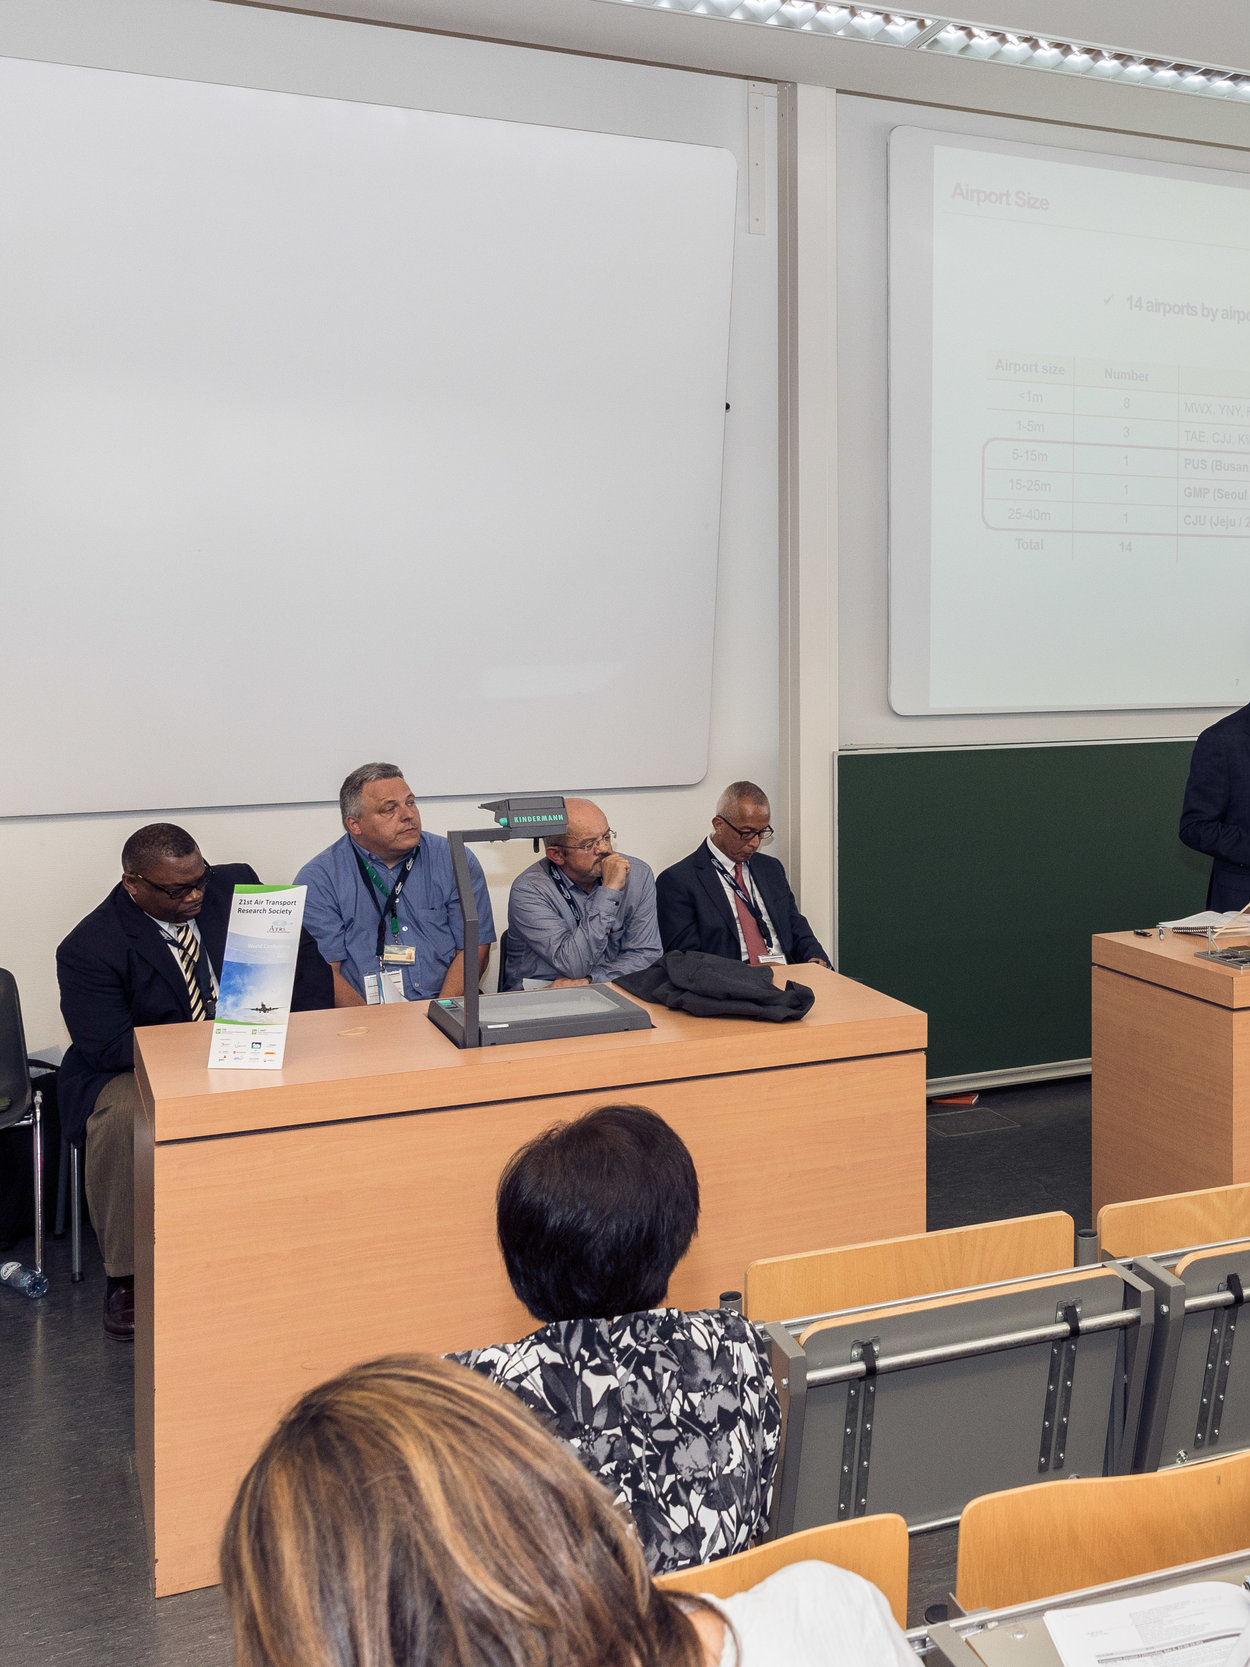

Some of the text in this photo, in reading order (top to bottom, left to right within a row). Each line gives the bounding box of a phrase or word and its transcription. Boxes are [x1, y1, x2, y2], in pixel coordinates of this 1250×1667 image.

[951, 182, 1049, 211] Airport Size
[1126, 296, 1143, 311] 14
[1146, 298, 1198, 317] airports
[1201, 303, 1218, 322] by
[995, 359, 1066, 376] Airport size
[1104, 367, 1149, 382] Number
[1016, 420, 1045, 432] 1-5m
[1012, 449, 1048, 462] 5-15m
[1184, 458, 1207, 471] PUS
[1211, 459, 1249, 474] (Busan
[1009, 479, 1052, 491] 15-25m
[1184, 486, 1210, 499] GMP
[1213, 488, 1247, 502] (Seoul
[1008, 507, 1051, 521] 25-40m
[1183, 514, 1206, 527] CJU
[1209, 515, 1236, 530] (Jeju
[1015, 538, 1044, 551] Total
[1119, 541, 1132, 552] 14
[513, 814, 564, 823] KINDERMANN
[266, 899, 297, 907] Transport
[268, 907, 293, 915] Society
